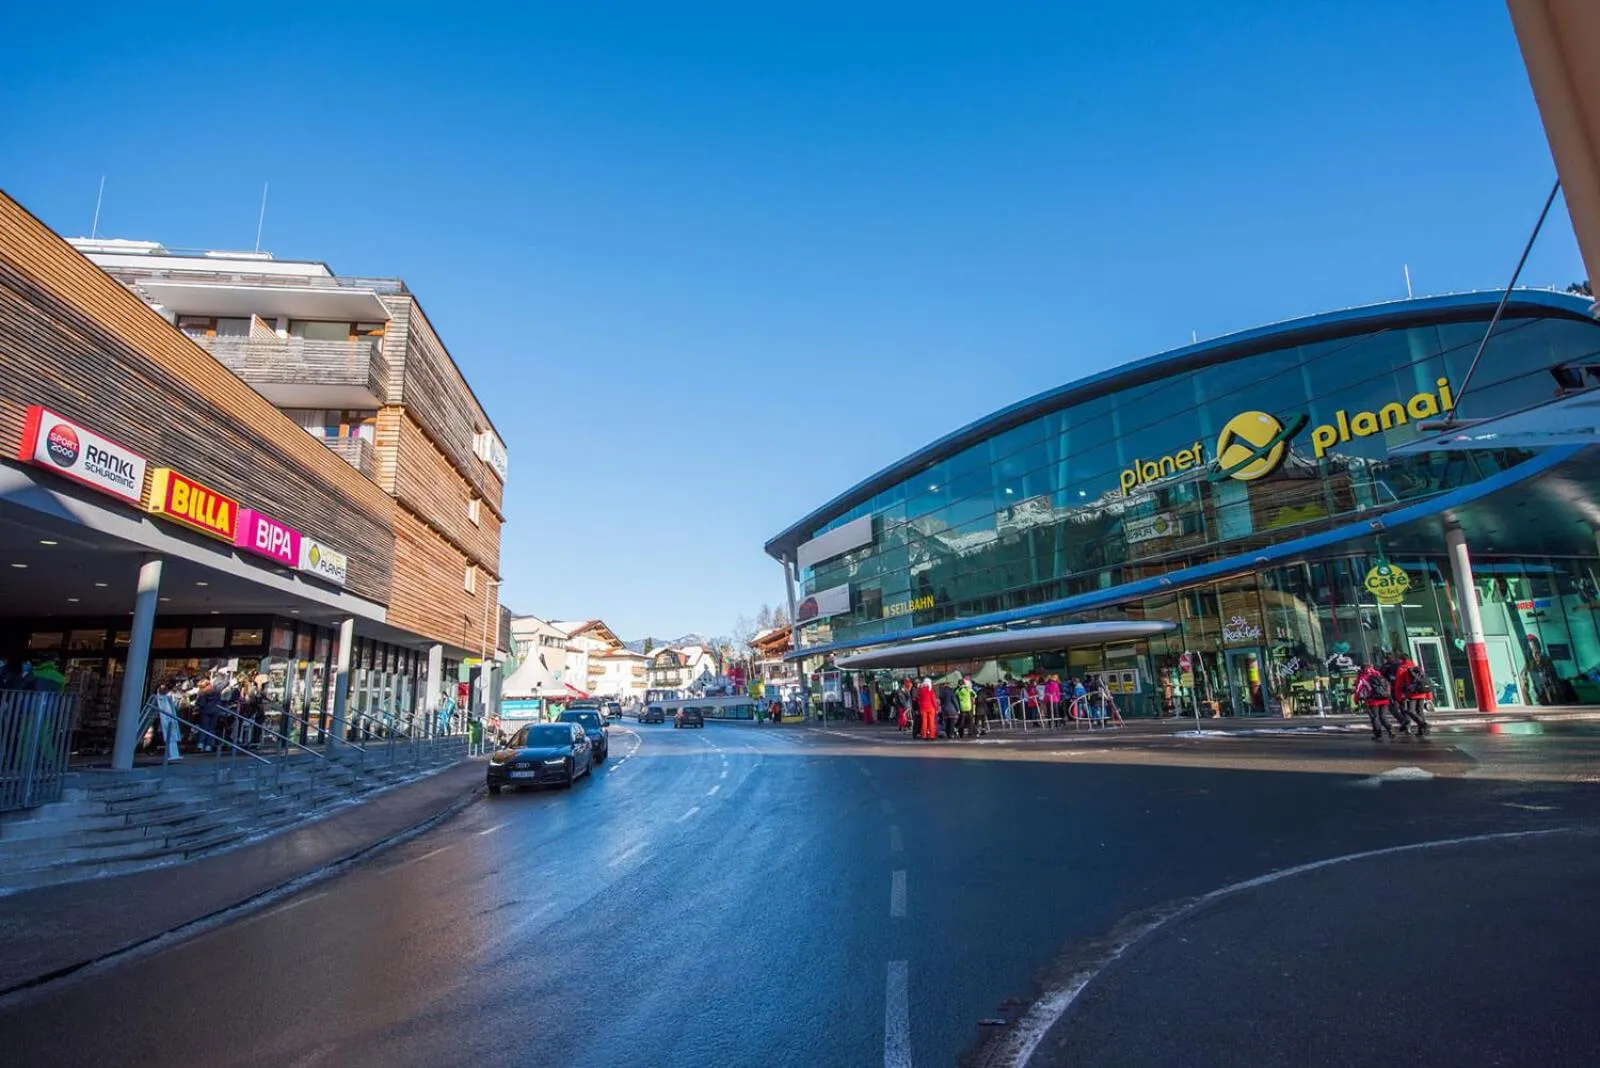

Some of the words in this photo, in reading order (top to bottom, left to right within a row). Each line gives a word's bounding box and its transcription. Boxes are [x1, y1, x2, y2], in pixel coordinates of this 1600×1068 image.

[50, 432, 79, 451] SPORT
[50, 442, 75, 458] 2000
[1120, 442, 1203, 497] planet
[1311, 376, 1454, 459] planai
[84, 461, 135, 490] SCHLADMING
[86, 444, 136, 480] RANKL
[171, 479, 230, 533] BILLA
[256, 518, 292, 560] BIPA
[1368, 572, 1408, 588] Café
